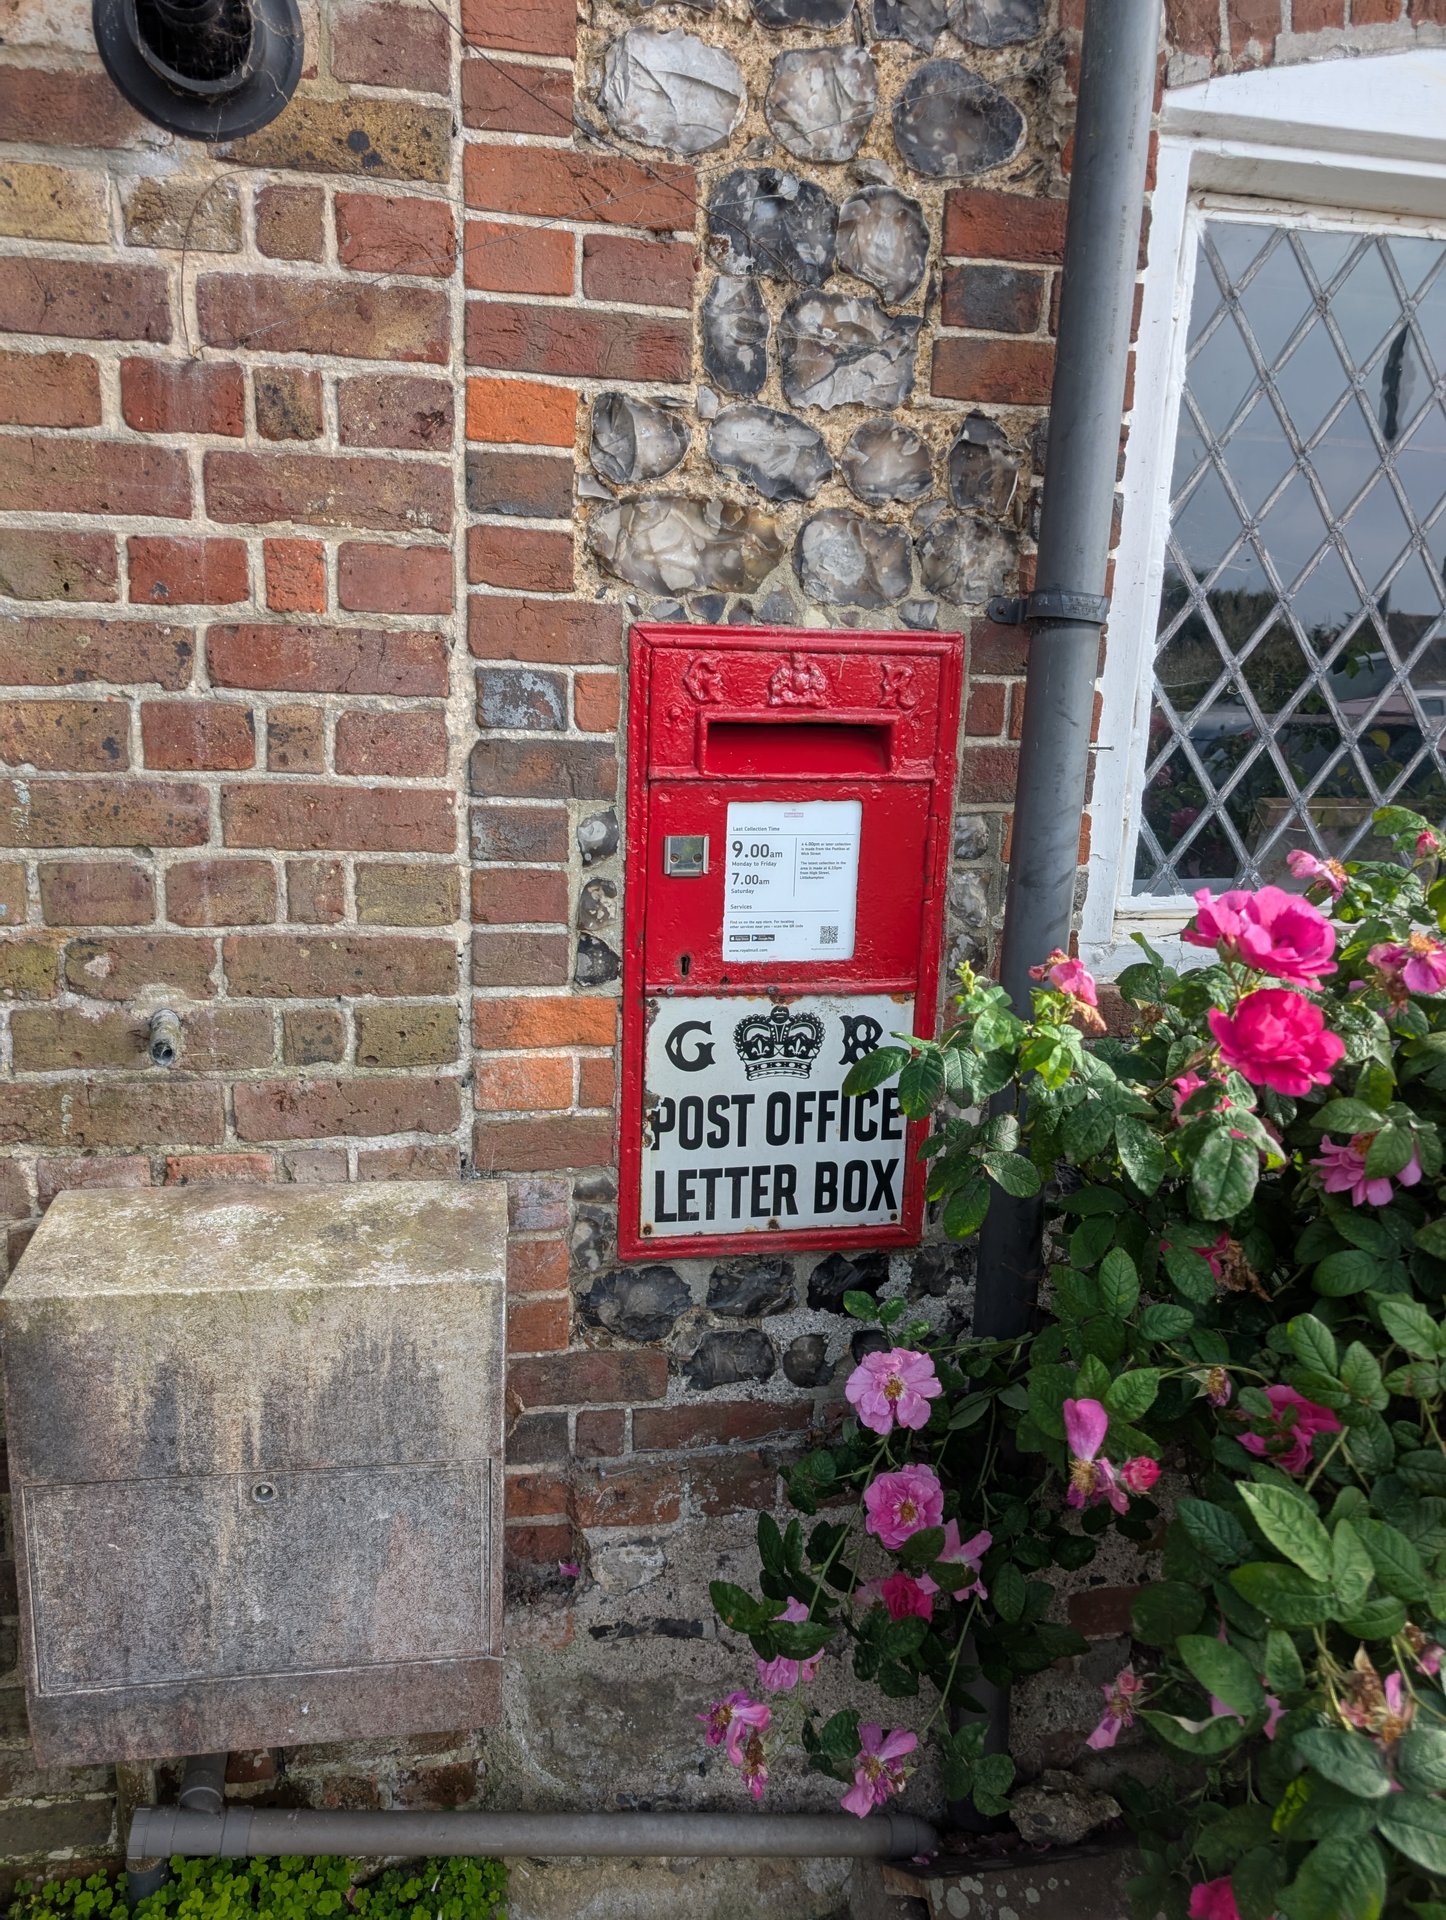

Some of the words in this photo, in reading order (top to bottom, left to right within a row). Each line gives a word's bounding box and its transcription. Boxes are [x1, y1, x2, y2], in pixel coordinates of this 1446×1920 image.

[878, 662, 924, 710] R
[732, 840, 783, 858] 9.00am
[732, 873, 770, 885] 7.00am
[664, 1020, 716, 1072] G
[838, 1014, 884, 1066] R
[650, 1094, 755, 1150] POST
[766, 1088, 902, 1146] OFFICE
[654, 1164, 798, 1223] LETTER
[814, 1158, 900, 1214] BOX
